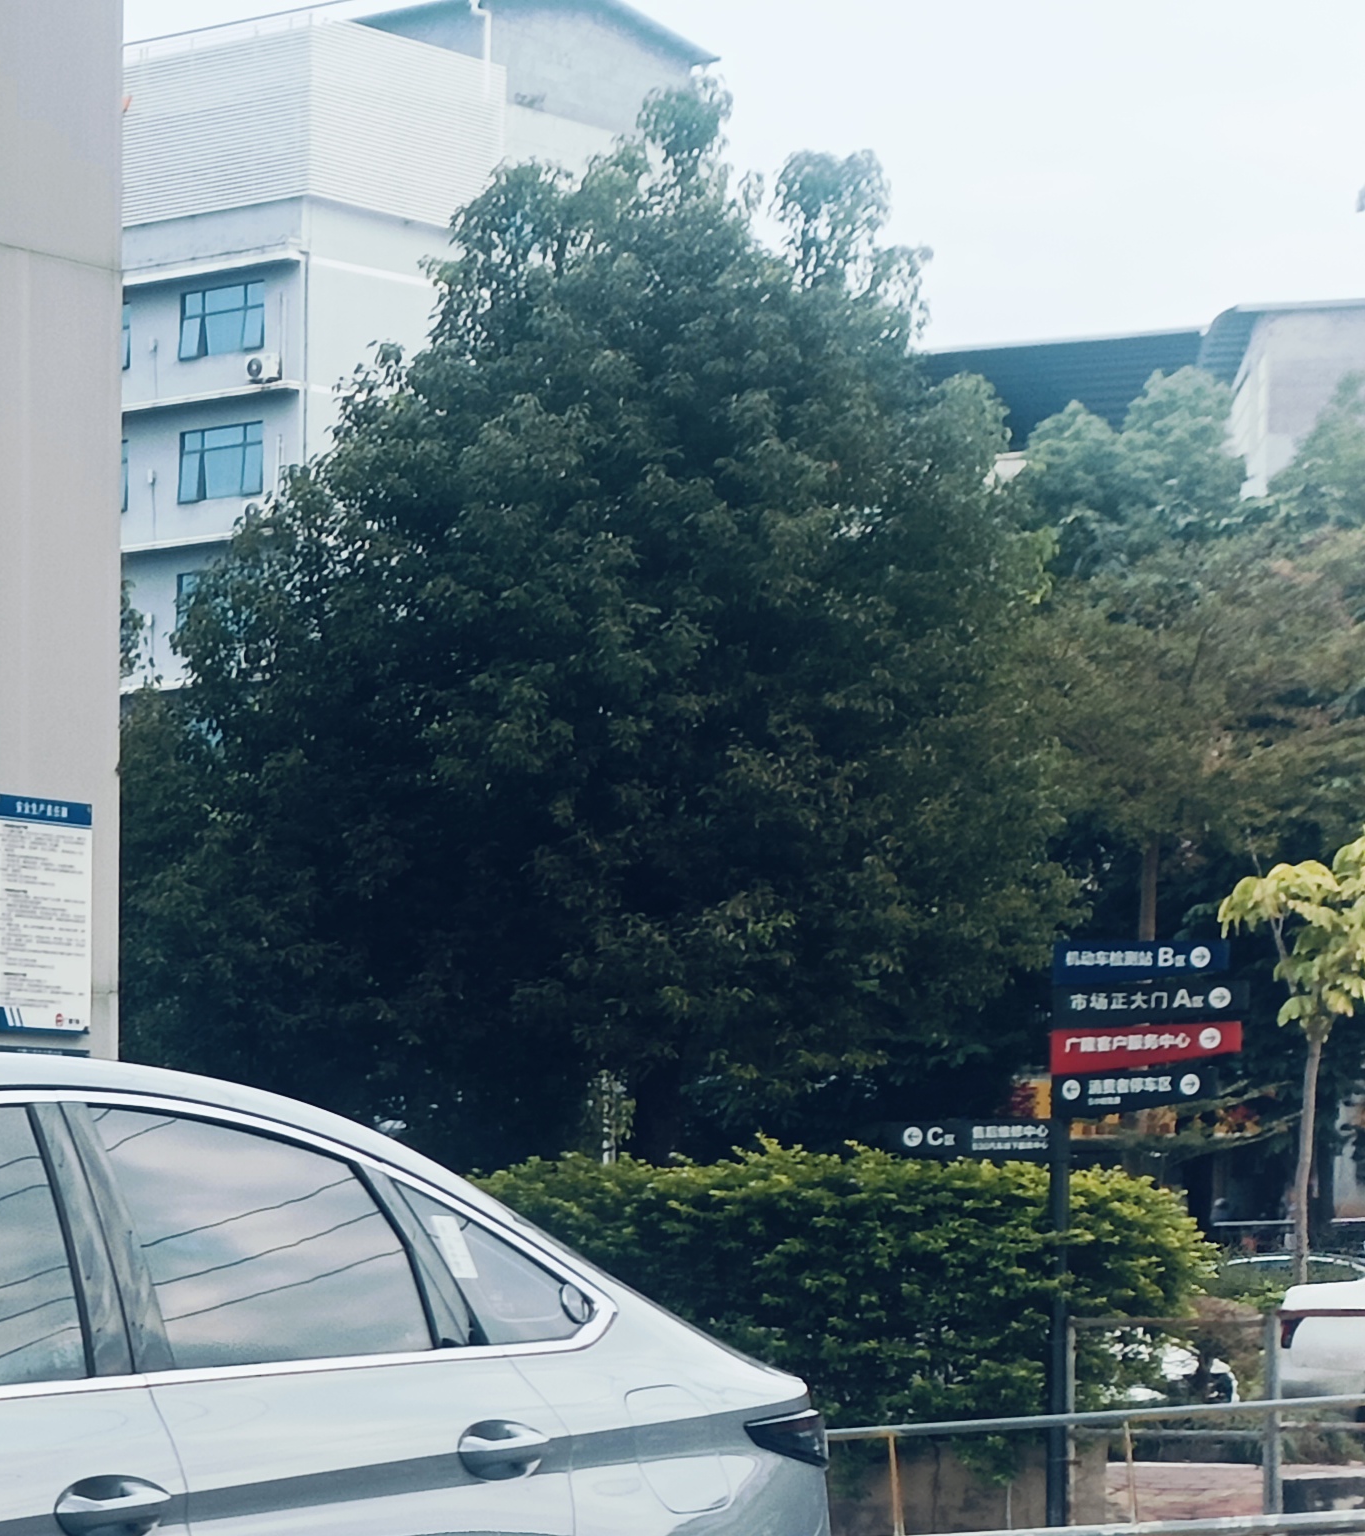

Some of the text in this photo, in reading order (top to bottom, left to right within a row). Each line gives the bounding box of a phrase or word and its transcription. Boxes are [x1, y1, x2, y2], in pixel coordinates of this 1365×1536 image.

[1071, 992, 1168, 1011] 市场正大门
